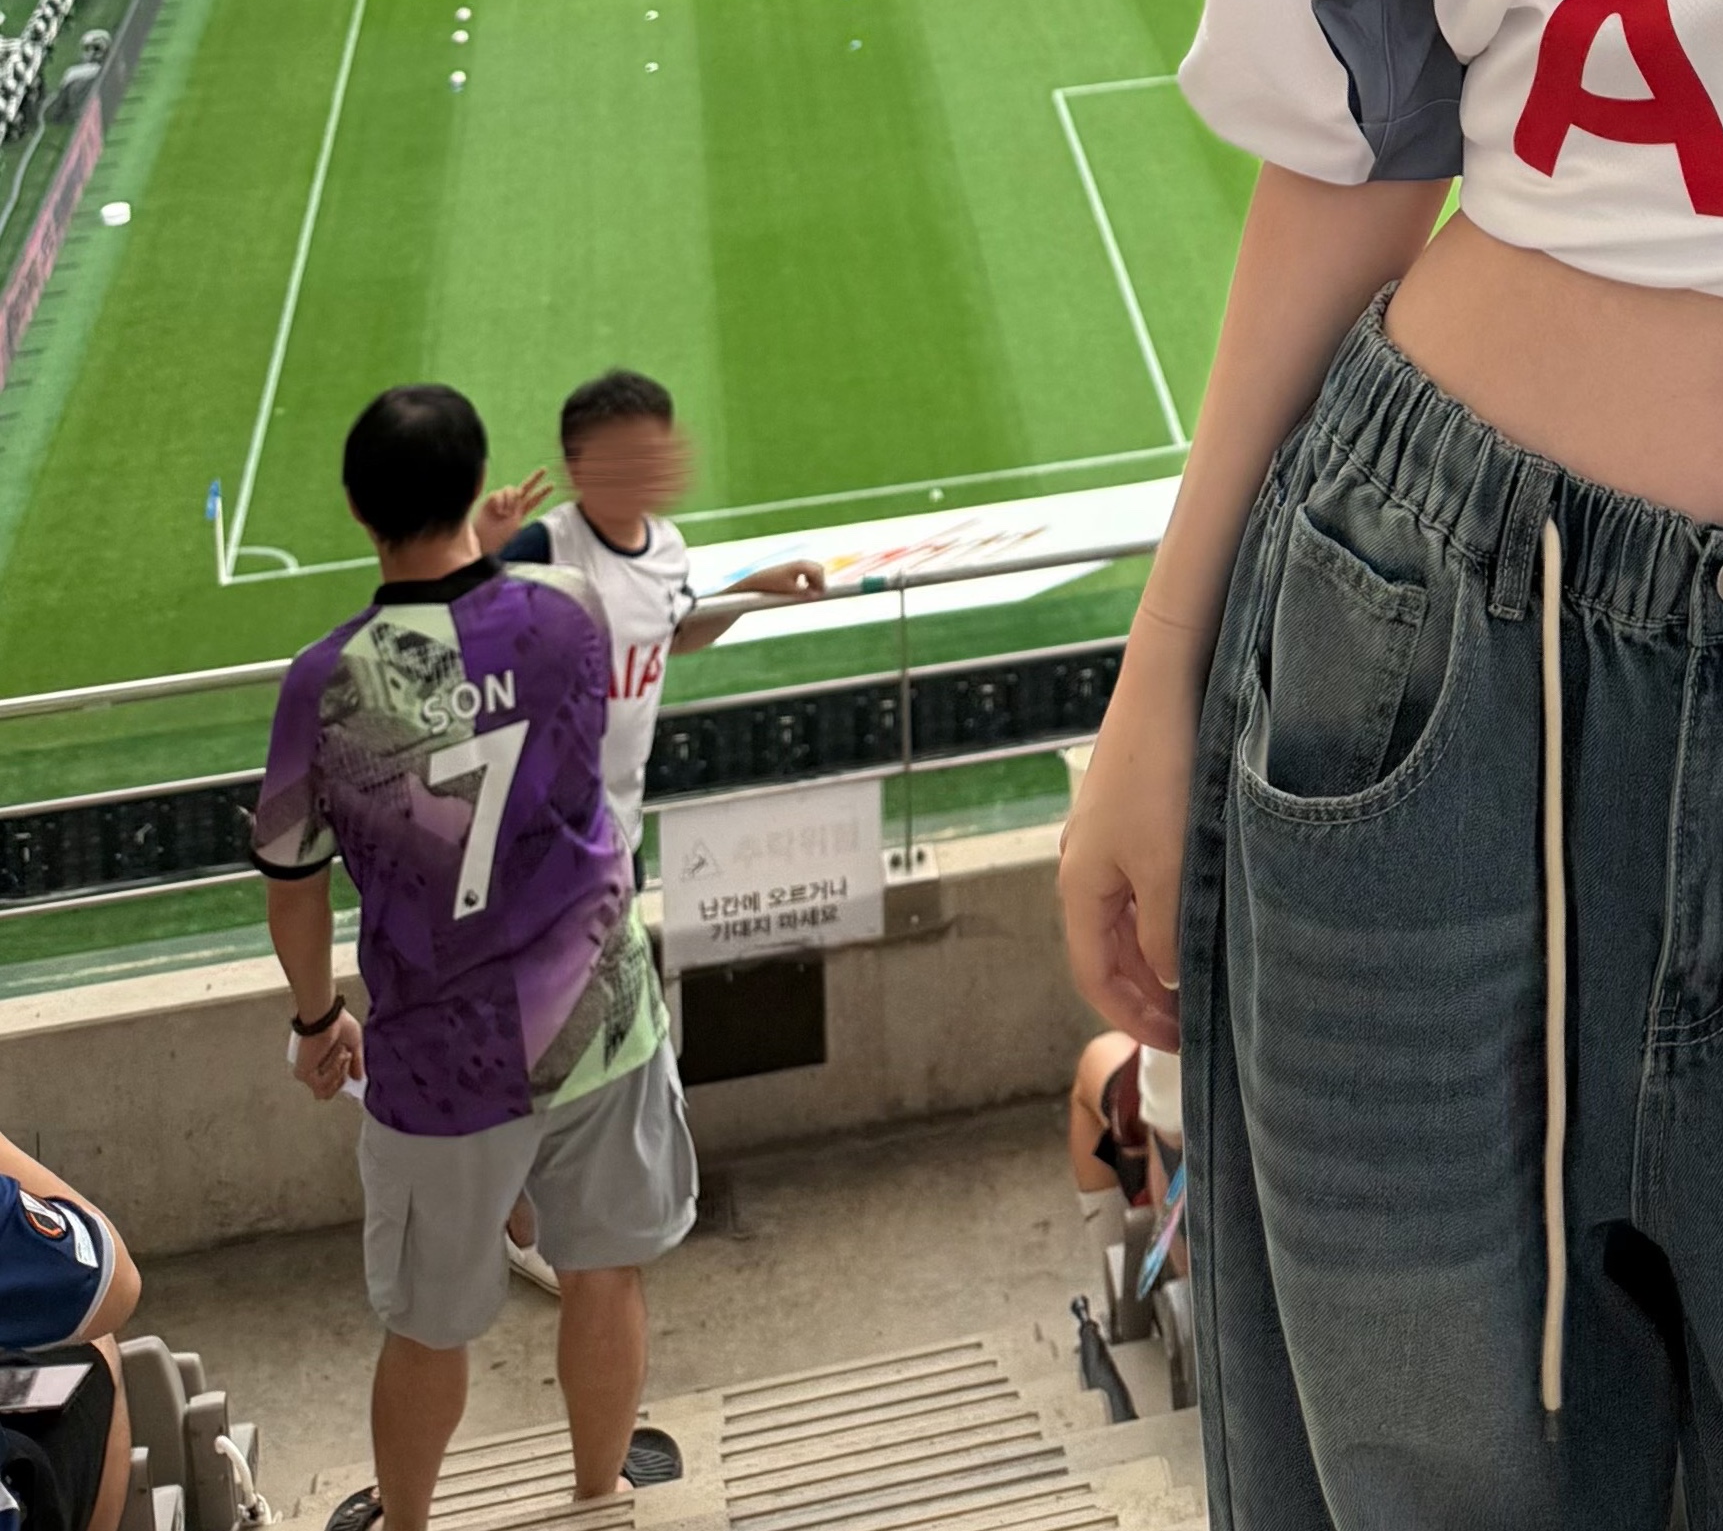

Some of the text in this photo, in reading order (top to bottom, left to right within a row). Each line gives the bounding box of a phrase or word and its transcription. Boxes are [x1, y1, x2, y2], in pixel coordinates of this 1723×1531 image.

[422, 669, 516, 735] SON
[428, 718, 530, 921] 7
[768, 874, 848, 907] 오르거나
